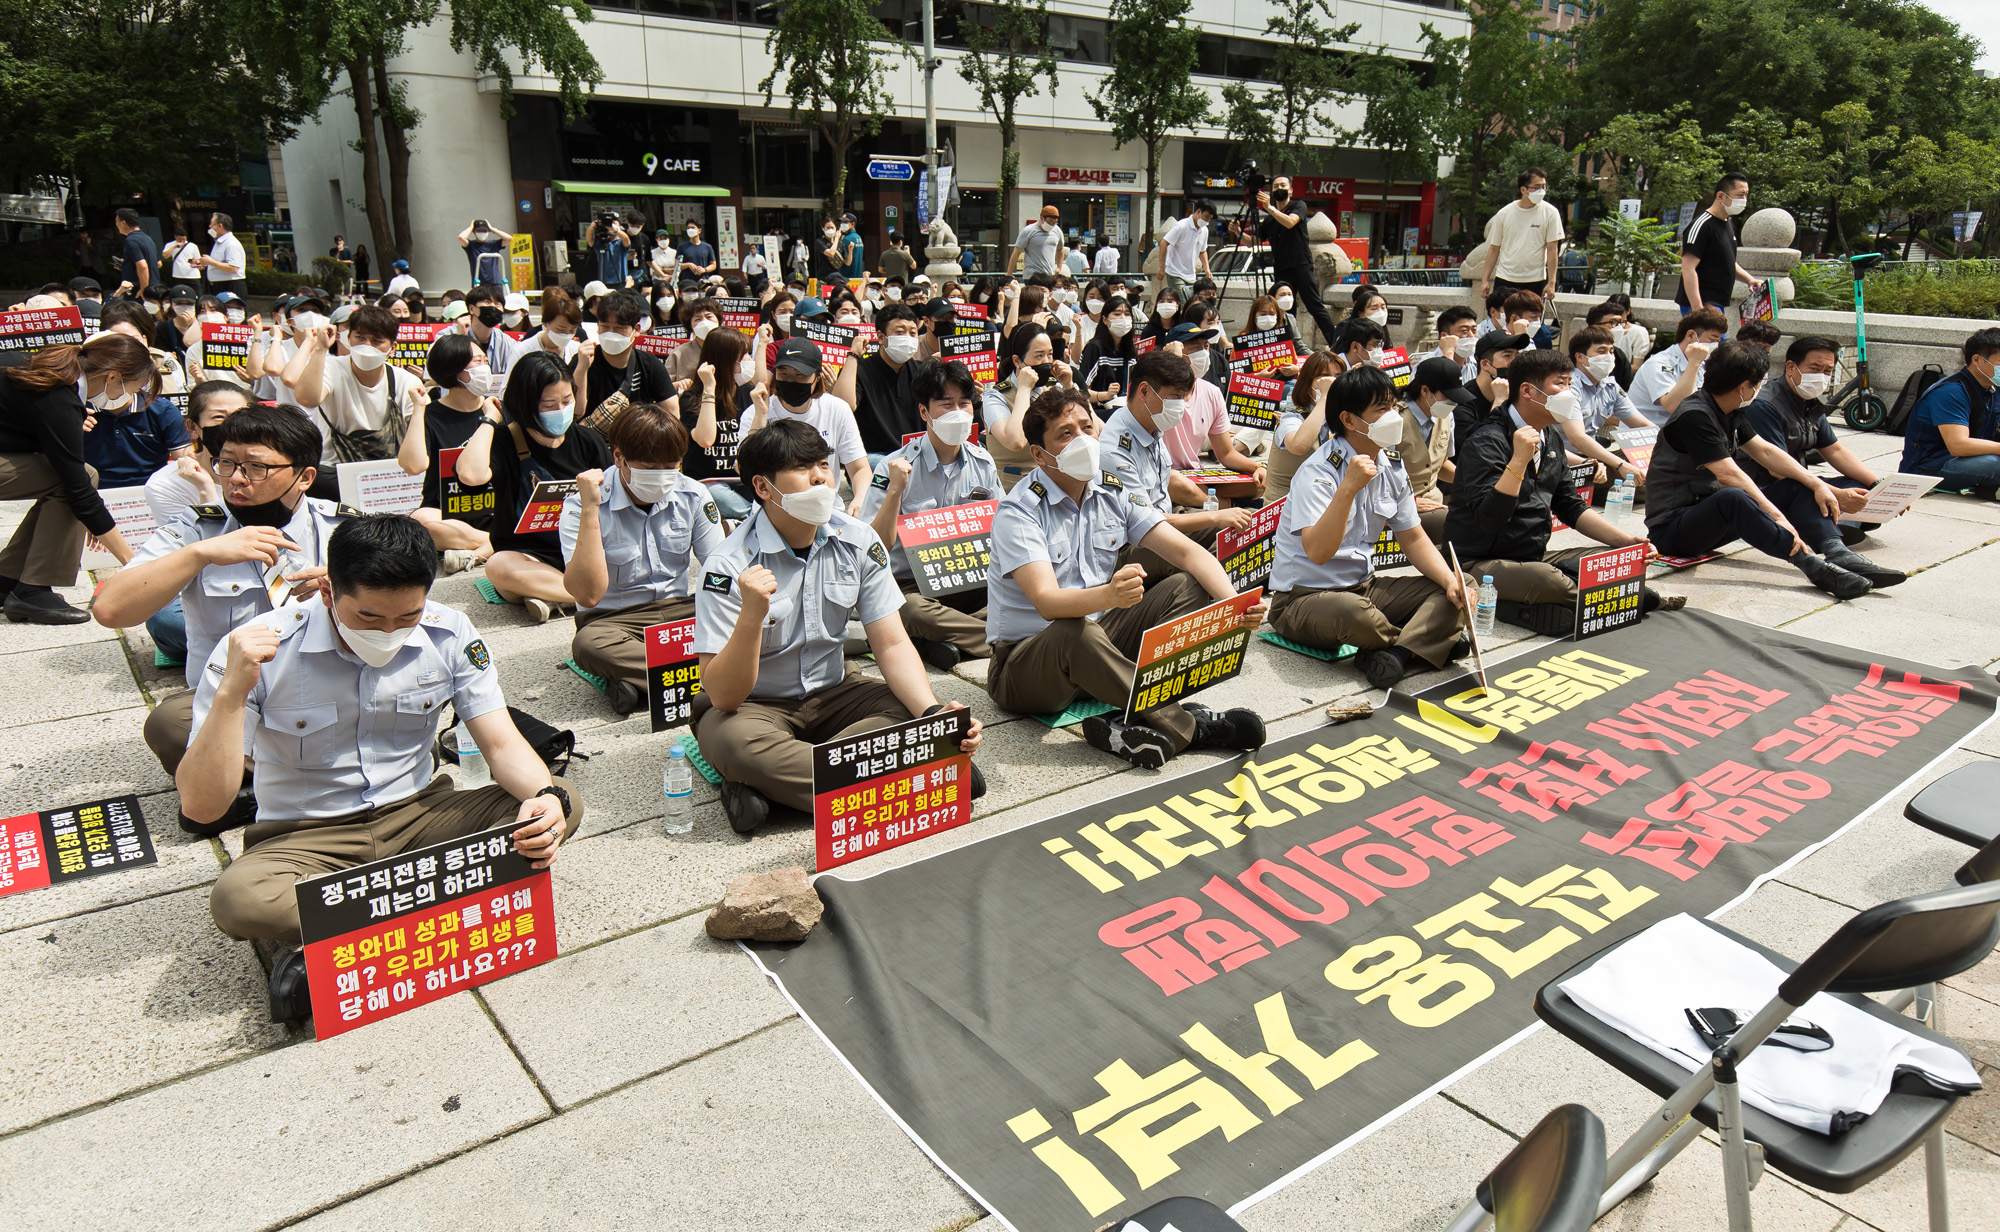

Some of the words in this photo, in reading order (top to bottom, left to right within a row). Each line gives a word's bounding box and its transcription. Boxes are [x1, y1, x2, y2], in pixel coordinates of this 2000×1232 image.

[664, 158, 700, 172] CAFE
[1060, 168, 1110, 184] 오피스디포
[1206, 178, 1235, 188] emart24
[1318, 181, 1344, 194] KFC
[1622, 204, 1628, 213] 3
[4, 311, 58, 324] 가정파탄내는
[24, 320, 52, 331] 직고용
[54, 319, 72, 328] 거부
[794, 319, 828, 333] 정규직전환
[828, 326, 854, 338] 중단하고
[25, 336, 44, 348] 전환
[46, 332, 83, 344] 합의이행
[806, 330, 826, 342] 재논의
[827, 334, 843, 344] 하라!
[944, 336, 970, 347] 정규직전환
[970, 334, 990, 344] 중단하고
[1236, 332, 1264, 344] 정규직전환
[1264, 328, 1286, 336] 중단하고
[1248, 340, 1264, 348] 재논의
[206, 344, 230, 354] 자회사
[230, 346, 246, 356] 전환
[954, 344, 970, 354] 재논의
[970, 344, 982, 352] 하라!
[206, 354, 240, 368] 대통령이
[976, 370, 995, 382] 개박살
[1235, 374, 1260, 386] 정규직전환
[1260, 380, 1280, 390] 중단하고
[1242, 384, 1258, 394] 재논의
[1258, 388, 1270, 396] 하라!
[1230, 404, 1240, 412] 왜?
[1240, 406, 1256, 416] 우리가
[1256, 410, 1274, 420] 희생을
[1231, 395, 1248, 406] 청와대
[1248, 399, 1264, 409] 성과를
[1264, 402, 1276, 411] 위해
[1245, 416, 1272, 428] 하나요???
[704, 446, 728, 457] BUT
[1576, 466, 1594, 478] 중단하고
[448, 492, 495, 514] 대통령이
[532, 513, 556, 522] 왜?
[904, 511, 955, 530] 정규직전환
[956, 504, 995, 521] 중단하고
[926, 524, 958, 540] 재논의
[958, 520, 984, 534] 하라!
[1236, 529, 1257, 548] 재논의
[1258, 520, 1274, 536] 하라!
[918, 546, 952, 563] 청와대
[952, 540, 985, 556] 성과를
[1224, 552, 1247, 573] 청와대
[1248, 538, 1270, 560] 성과를
[1586, 554, 1618, 572] 정규직전환
[1619, 548, 1643, 565] 중단하고
[923, 563, 942, 577] 왜?
[944, 556, 979, 573] 우리가
[1240, 555, 1262, 576] 우리가
[1596, 569, 1616, 582] 재논의
[1617, 564, 1632, 578] 하라!
[928, 574, 964, 592] 당해야
[1584, 589, 1605, 606] 청와대
[1606, 584, 1626, 600] 성과를
[1627, 580, 1640, 595] 위해
[1583, 606, 1596, 620] 왜?
[1596, 600, 1618, 616] 우리가
[1618, 594, 1639, 610] 희생을
[1170, 604, 1234, 638] 가정파탄내는
[1582, 618, 1604, 634] 당해야
[1605, 608, 1638, 628] 하나요???
[1153, 636, 1186, 660] 일방적
[1188, 621, 1220, 643] 직고용
[1140, 661, 1176, 688] 자회사
[1177, 650, 1200, 673] 전환
[1202, 632, 1246, 662] 합의이행
[662, 664, 700, 687] 청와대
[1134, 673, 1186, 713] 대통령이
[1188, 651, 1241, 688] 책임져라!
[663, 686, 686, 704] 왜?
[1393, 648, 1650, 755] 대통령이
[1584, 668, 1791, 756] 자회사
[828, 731, 901, 766] 정규직전환
[904, 716, 958, 746] 중단하고
[856, 752, 898, 779] 재논의
[902, 743, 935, 766] 하라!
[830, 788, 876, 817] 청와대
[882, 773, 926, 801] 성과를
[930, 764, 958, 787] 위해
[1456, 738, 1653, 825] 전환
[50, 811, 76, 828] 위해
[78, 806, 104, 829] 희생을
[106, 802, 136, 837] 하나요???
[831, 816, 858, 838] 왜?
[862, 800, 910, 828] 우리가
[914, 784, 958, 812] 희생을
[1040, 734, 1441, 894] 책임져라!
[832, 829, 880, 860] 당해야
[886, 805, 958, 841] 하나요???
[1580, 770, 1832, 881] 일방적
[14, 830, 37, 849] 하라!
[54, 825, 81, 850] 성과를
[84, 828, 112, 853] 우리가
[115, 835, 144, 862] 당해야
[15, 847, 41, 871] 재논의
[58, 847, 87, 874] 청와대
[90, 852, 115, 868] 왜?
[321, 856, 438, 906] 정규직전환
[368, 882, 436, 920] 재논의
[442, 866, 493, 896] 하라!
[1098, 794, 1518, 998] 합의이행
[332, 928, 406, 969] 청와대
[414, 904, 483, 943] 성과를
[490, 887, 532, 919] 위해
[336, 966, 377, 996] 왜?
[386, 940, 460, 978] 우리가
[468, 912, 535, 952] 희생을
[1323, 863, 1660, 1029] 직고용
[340, 978, 416, 1022] 당해야
[424, 938, 538, 992] 하나요???
[1004, 990, 1380, 1219] 거부!
